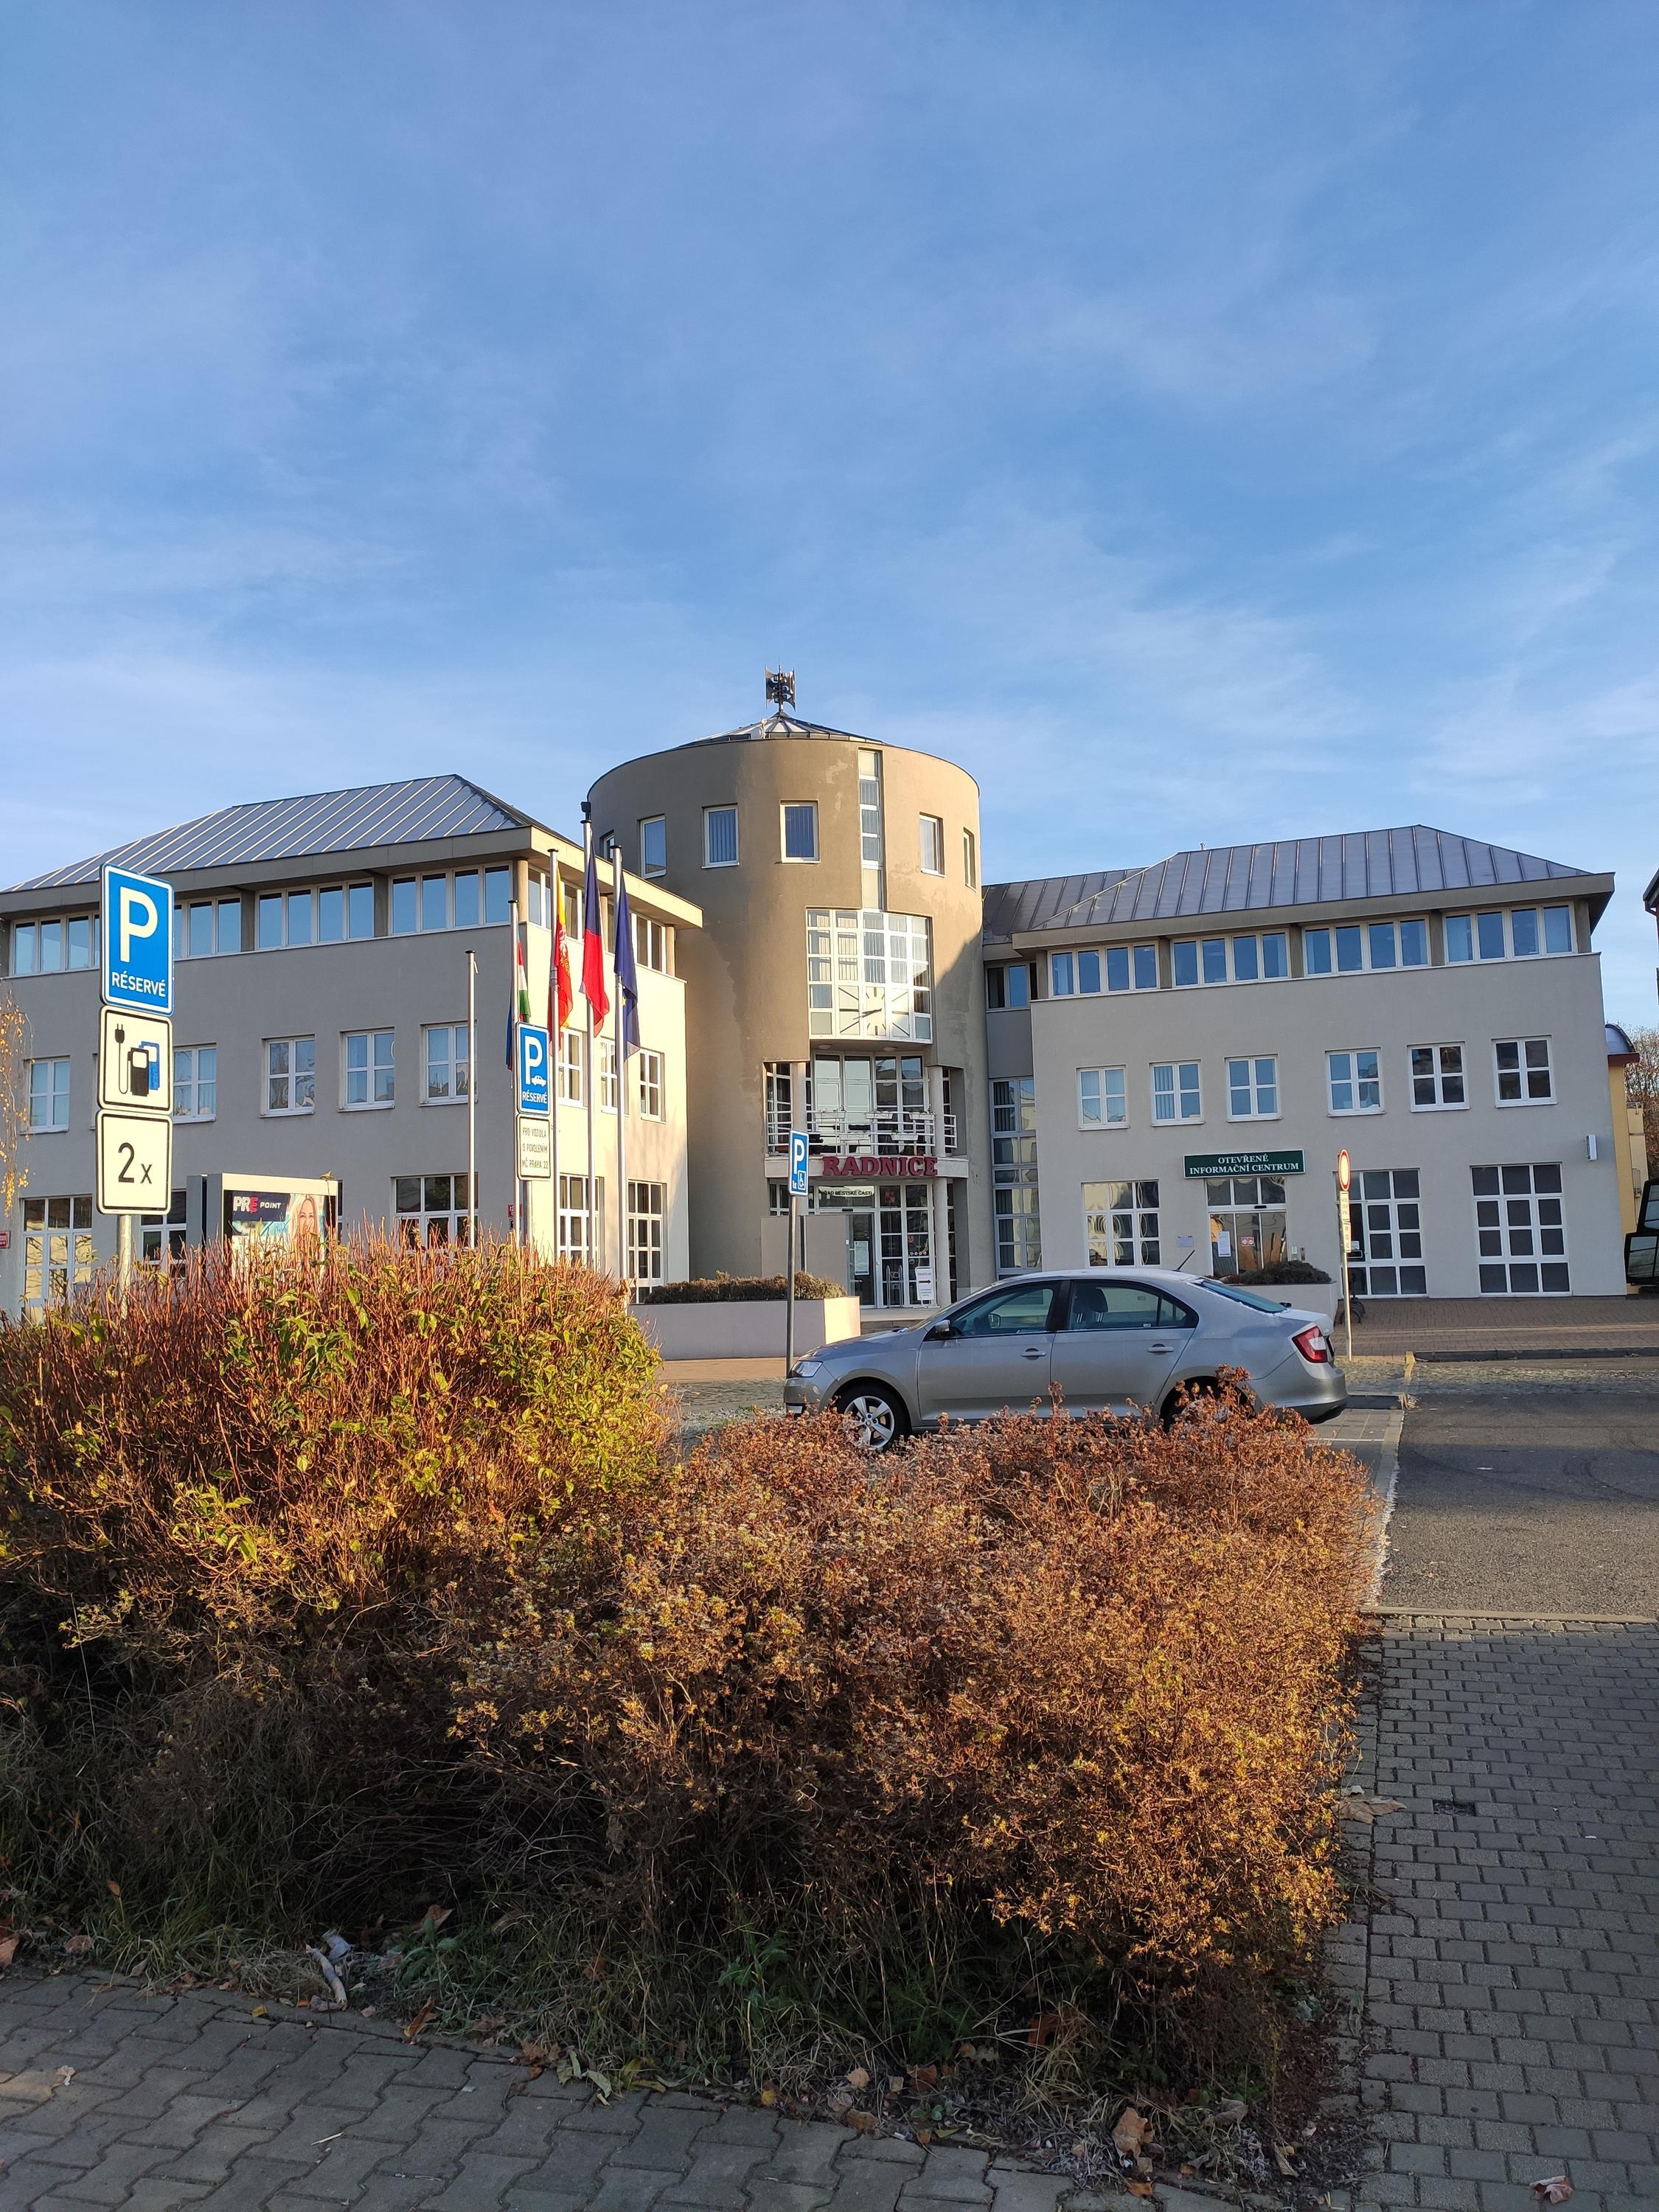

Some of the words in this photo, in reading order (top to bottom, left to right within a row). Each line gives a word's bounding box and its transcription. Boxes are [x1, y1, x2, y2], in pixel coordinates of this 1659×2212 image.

[119, 886, 159, 963] P
[111, 970, 166, 998] RÉSERVÉ
[524, 1035, 543, 1085] P
[522, 1089, 548, 1104] RÉSERVÉ
[543, 1161, 549, 1169] 22
[793, 1138, 805, 1175] P
[822, 1155, 938, 1177] RADNICE
[1218, 1153, 1269, 1164] OTEVŘENÉ
[1189, 1163, 1250, 1175] INFORMAČNÍ
[1251, 1162, 1299, 1172] CENTRUM
[232, 1195, 259, 1214] PRE
[260, 1201, 282, 1210] POINT
